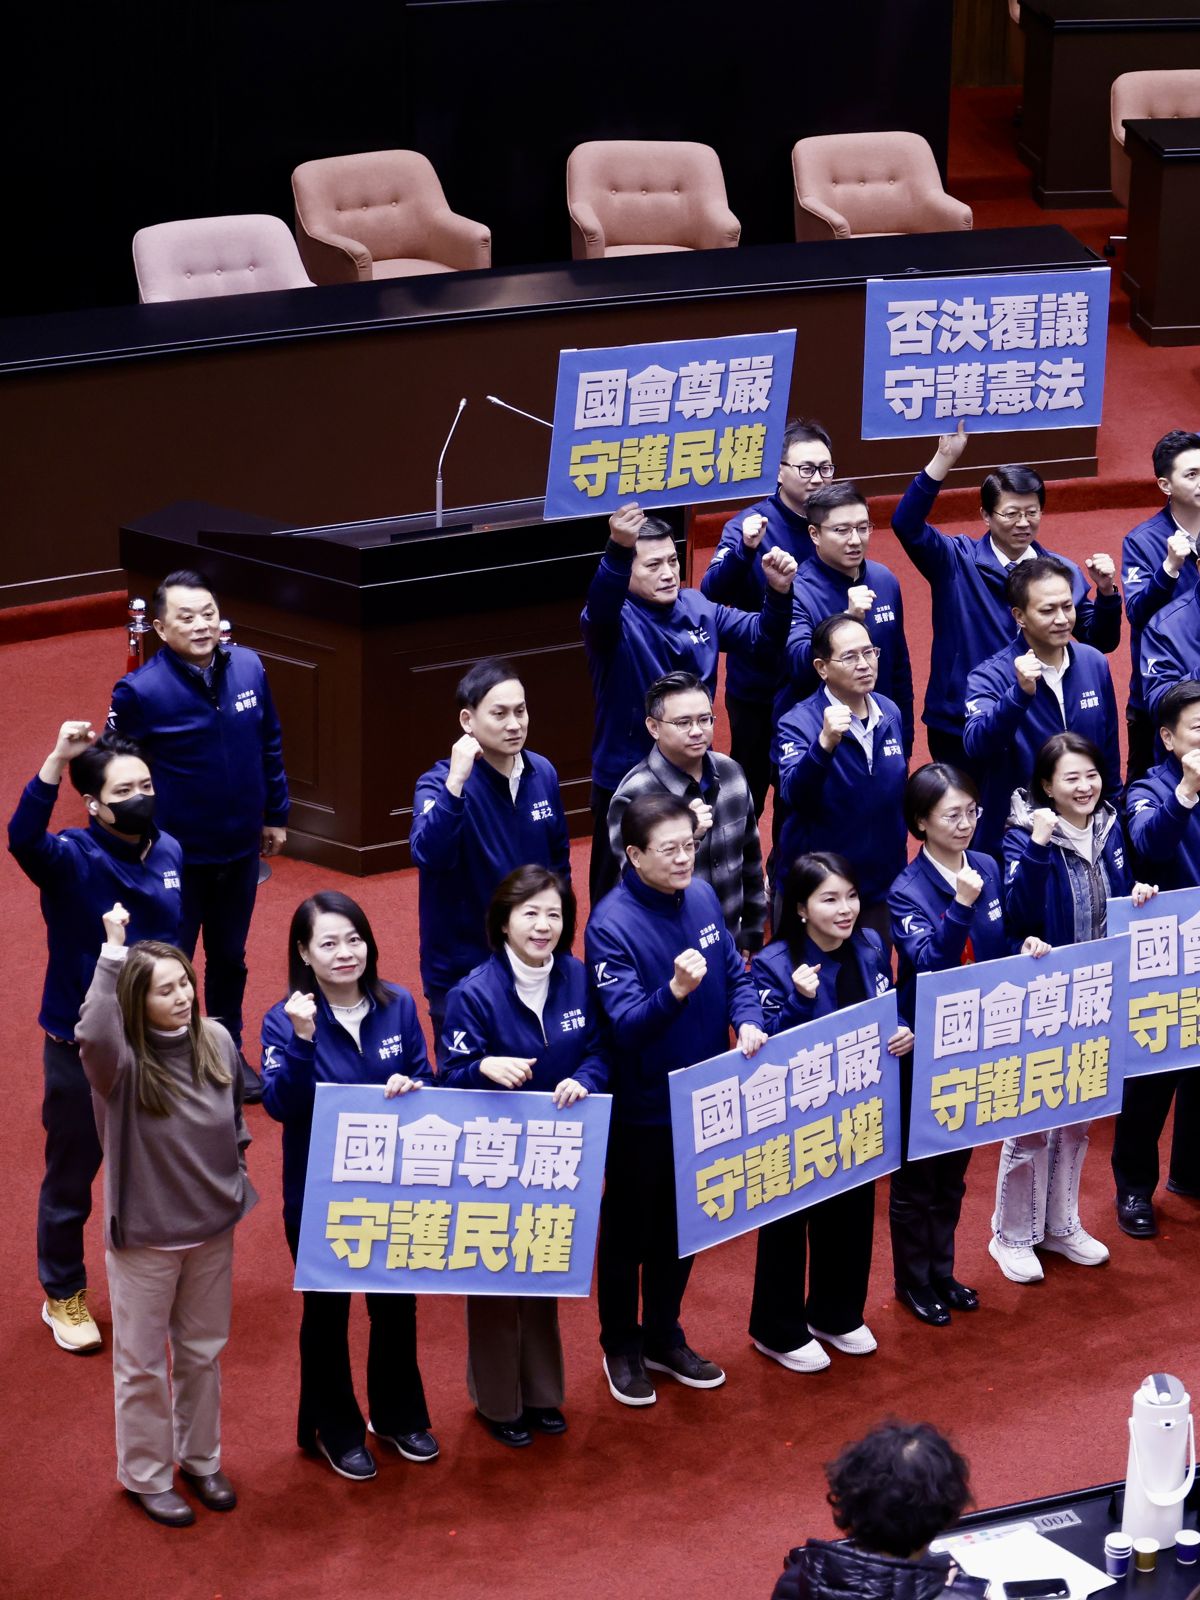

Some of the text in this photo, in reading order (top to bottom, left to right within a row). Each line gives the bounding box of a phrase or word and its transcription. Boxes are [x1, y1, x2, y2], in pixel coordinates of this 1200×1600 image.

[886, 291, 1089, 356] 否決覆議
[574, 355, 774, 430] 國會尊嚴
[884, 357, 1085, 420] 守護憲法
[569, 423, 767, 497] 守護民權
[933, 961, 1114, 1060] 國會尊嚴
[692, 1022, 883, 1154] 國會尊嚴
[930, 1035, 1111, 1133] 守護民權
[332, 1112, 584, 1191] 國會尊嚴
[696, 1096, 884, 1222] 守護民權
[325, 1197, 576, 1273] 守護民權
[1041, 1513, 1074, 1528] 004
